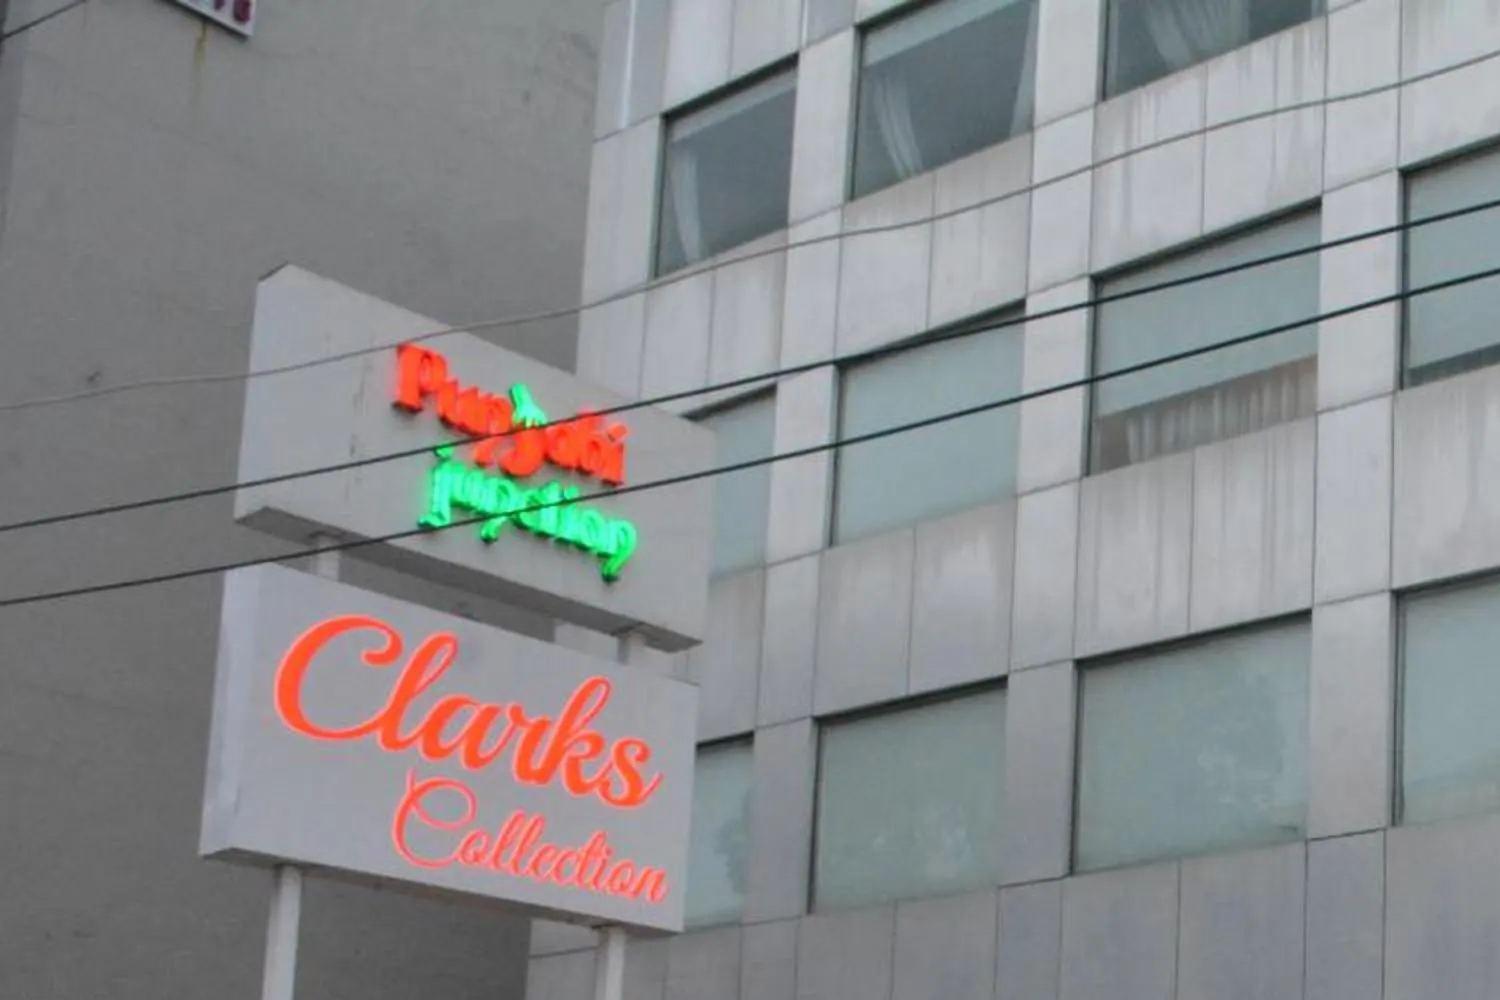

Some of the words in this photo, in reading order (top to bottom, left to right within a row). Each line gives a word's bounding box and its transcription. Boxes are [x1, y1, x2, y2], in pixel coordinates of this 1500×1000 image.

[393, 340, 630, 489] Punjabi
[274, 614, 663, 808] Clarks
[392, 769, 669, 903] Collection
